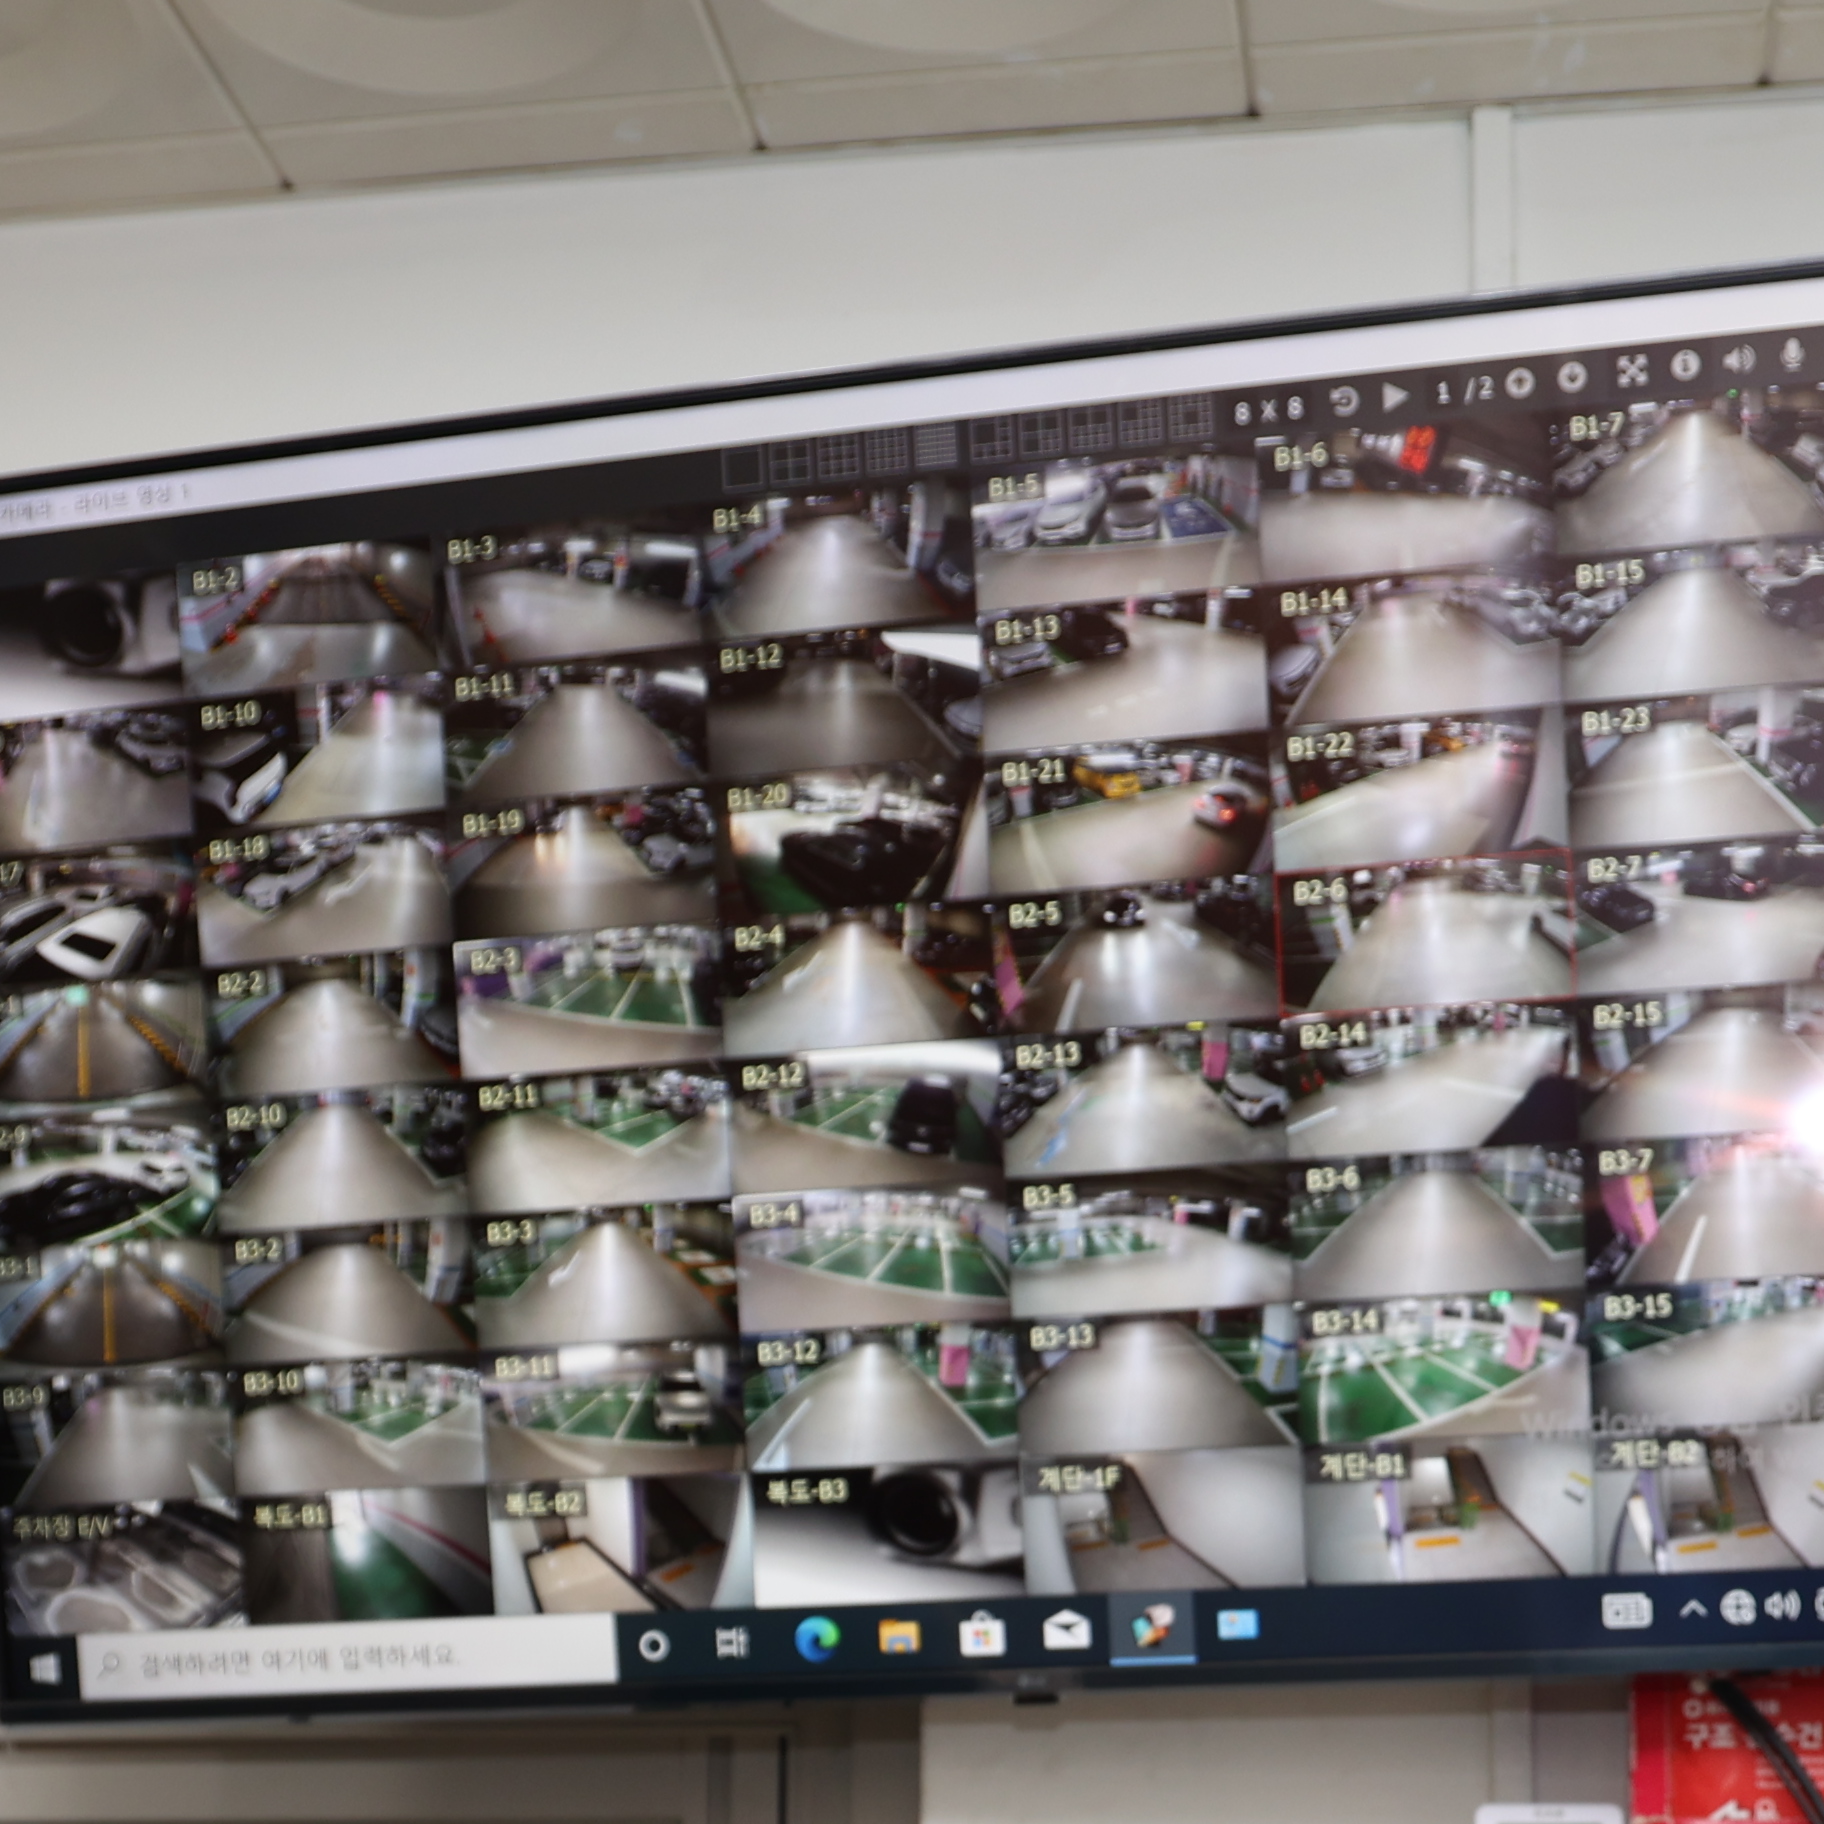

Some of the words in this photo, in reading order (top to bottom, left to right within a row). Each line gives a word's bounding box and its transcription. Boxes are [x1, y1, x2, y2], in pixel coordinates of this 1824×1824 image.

[1436, 380, 1451, 405] 1
[1234, 401, 1252, 426] 8
[1287, 395, 1305, 420] 8
[1568, 412, 1625, 442] B1-7
[1273, 442, 1327, 470] B1-6
[987, 472, 1038, 500] B1-5
[711, 504, 761, 532] B1-4
[447, 535, 497, 563] B1-3
[192, 566, 241, 593] B1-2
[1575, 559, 1645, 589] B1-15
[1280, 587, 1347, 616] B1-14
[994, 615, 1058, 642] B1-13
[720, 642, 782, 671] B1-12
[454, 671, 515, 699] B1-11
[200, 700, 261, 729] B1-10
[1581, 707, 1650, 735] B1-23
[1286, 732, 1355, 761] B1-22
[1001, 757, 1065, 785] B1-21
[727, 781, 790, 809] B1-20
[462, 807, 525, 836] B1-19
[207, 834, 271, 863] B1-18
[1586, 855, 1643, 882] B2-7
[1293, 877, 1347, 906] B2-6
[1008, 902, 1061, 929] B2-5
[734, 924, 784, 953] B2-4
[470, 946, 520, 973] B2-3
[217, 970, 265, 996] B2-2
[1593, 1001, 1662, 1030] B2-15
[1299, 1021, 1367, 1051] B2-14
[1016, 1041, 1082, 1070] B2-13
[741, 1063, 803, 1091] B2-12
[478, 1082, 538, 1109] B2-11
[226, 1102, 283, 1130] B2-10
[1598, 1146, 1654, 1175] B3-7
[1306, 1165, 1360, 1193] B3-6
[1022, 1183, 1074, 1209] B3-5
[749, 1201, 798, 1227] B3-4
[487, 1219, 535, 1245] B3-3
[233, 1237, 282, 1262] B3-2
[1603, 1292, 1673, 1321] B3-15
[1312, 1308, 1379, 1336] B3-14
[1030, 1324, 1094, 1351] B3-13
[757, 1338, 820, 1367] B3-12
[493, 1354, 553, 1380] B3-11
[243, 1369, 301, 1394] B3-10
[2, 1385, 45, 1407] B3-9
[1038, 1463, 1121, 1494] 계단-1F
[1320, 1451, 1405, 1481] 계단-B1
[766, 1478, 850, 1506] 복도-B3
[77, 1514, 112, 1536] E/V
[253, 1504, 328, 1530] 복도-B1
[140, 1653, 249, 1679] 검색하려면
[261, 1647, 329, 1673] 여기에
[1683, 1723, 1737, 1749] 구조
